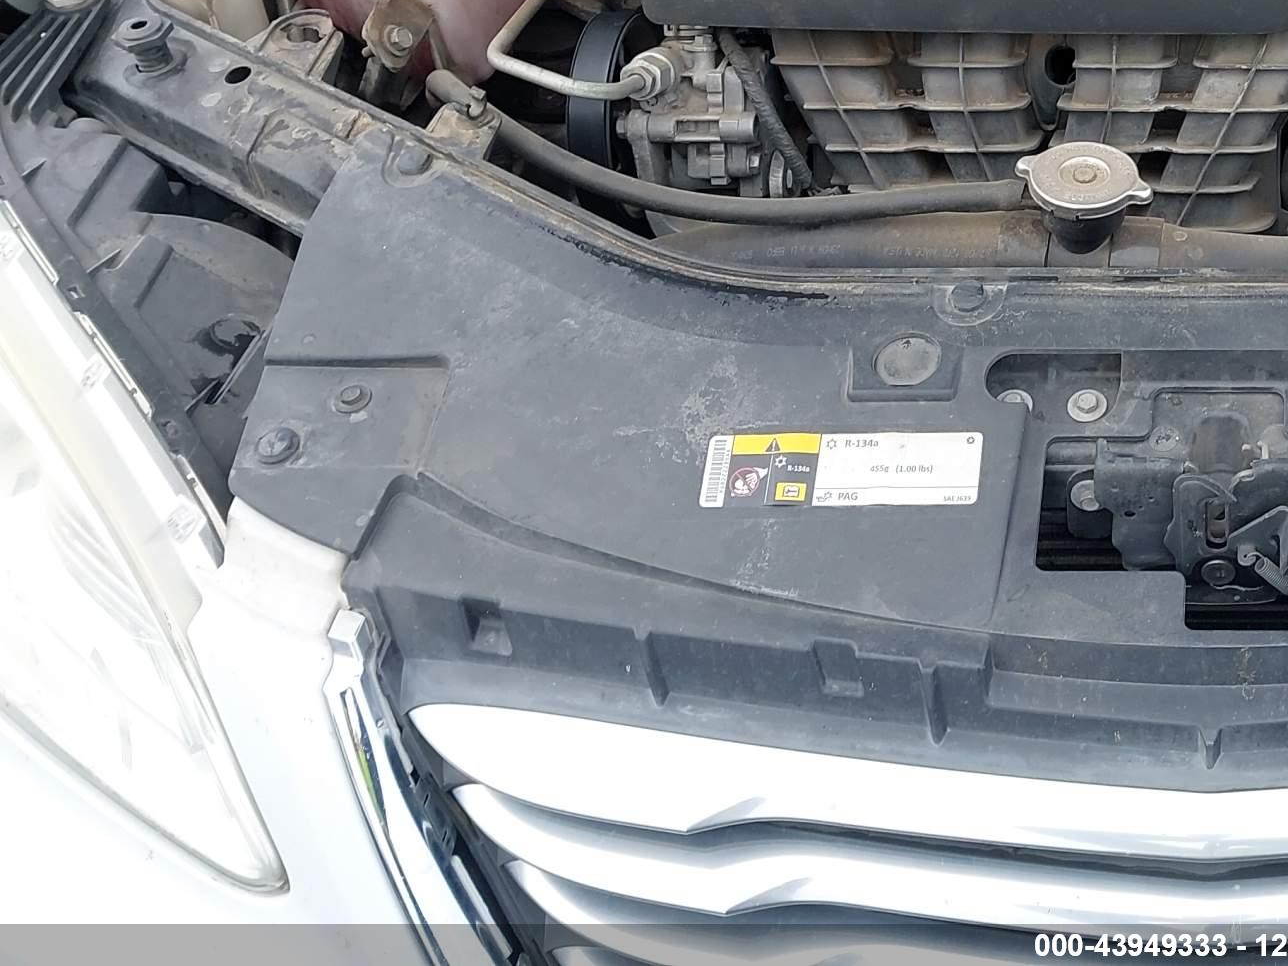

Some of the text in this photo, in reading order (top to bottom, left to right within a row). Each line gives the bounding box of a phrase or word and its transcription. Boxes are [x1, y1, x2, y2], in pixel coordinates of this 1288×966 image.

[844, 439, 879, 449] R-134a
[787, 464, 811, 473] R-134a
[895, 464, 917, 475] (1.00
[918, 464, 934, 475] lbs)
[838, 491, 859, 501] PAG
